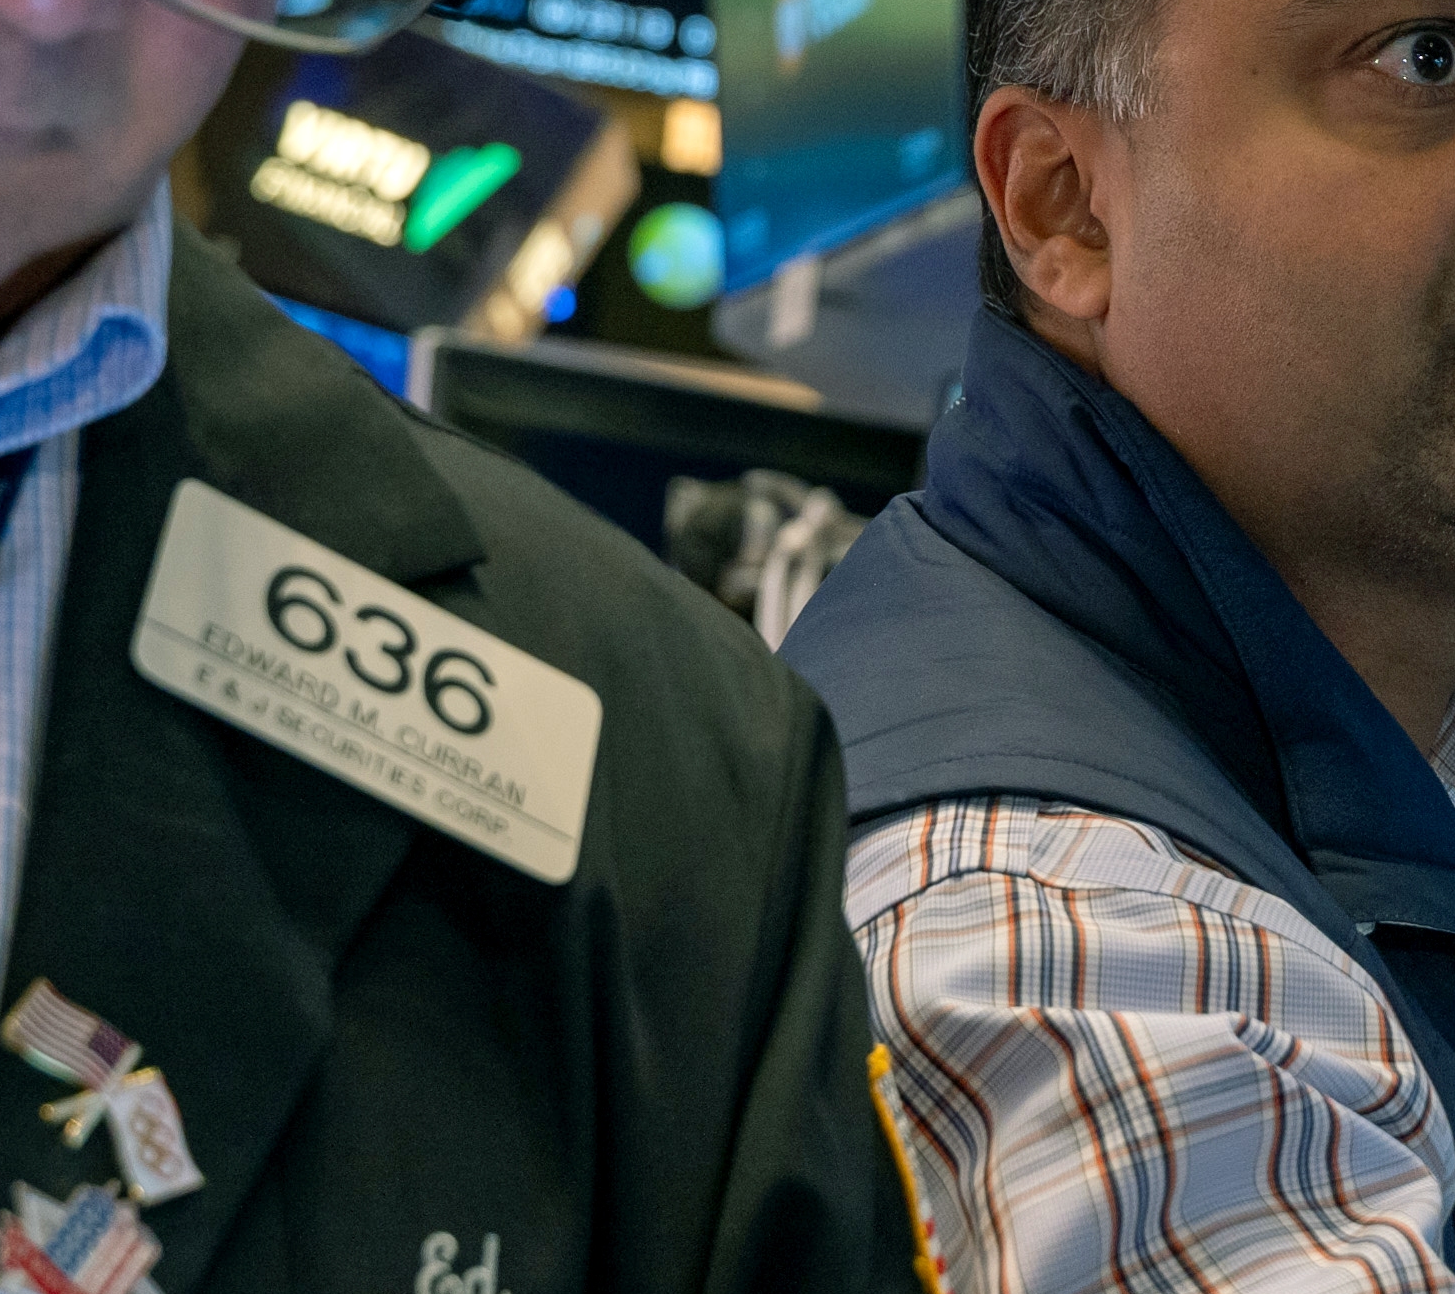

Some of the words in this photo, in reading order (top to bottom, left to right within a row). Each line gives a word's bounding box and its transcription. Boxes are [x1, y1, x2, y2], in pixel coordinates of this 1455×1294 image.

[201, 621, 341, 709] EDWARD
[398, 724, 528, 807] CURRAN
[264, 564, 497, 737] 636
[276, 706, 427, 795] SECURITIES
